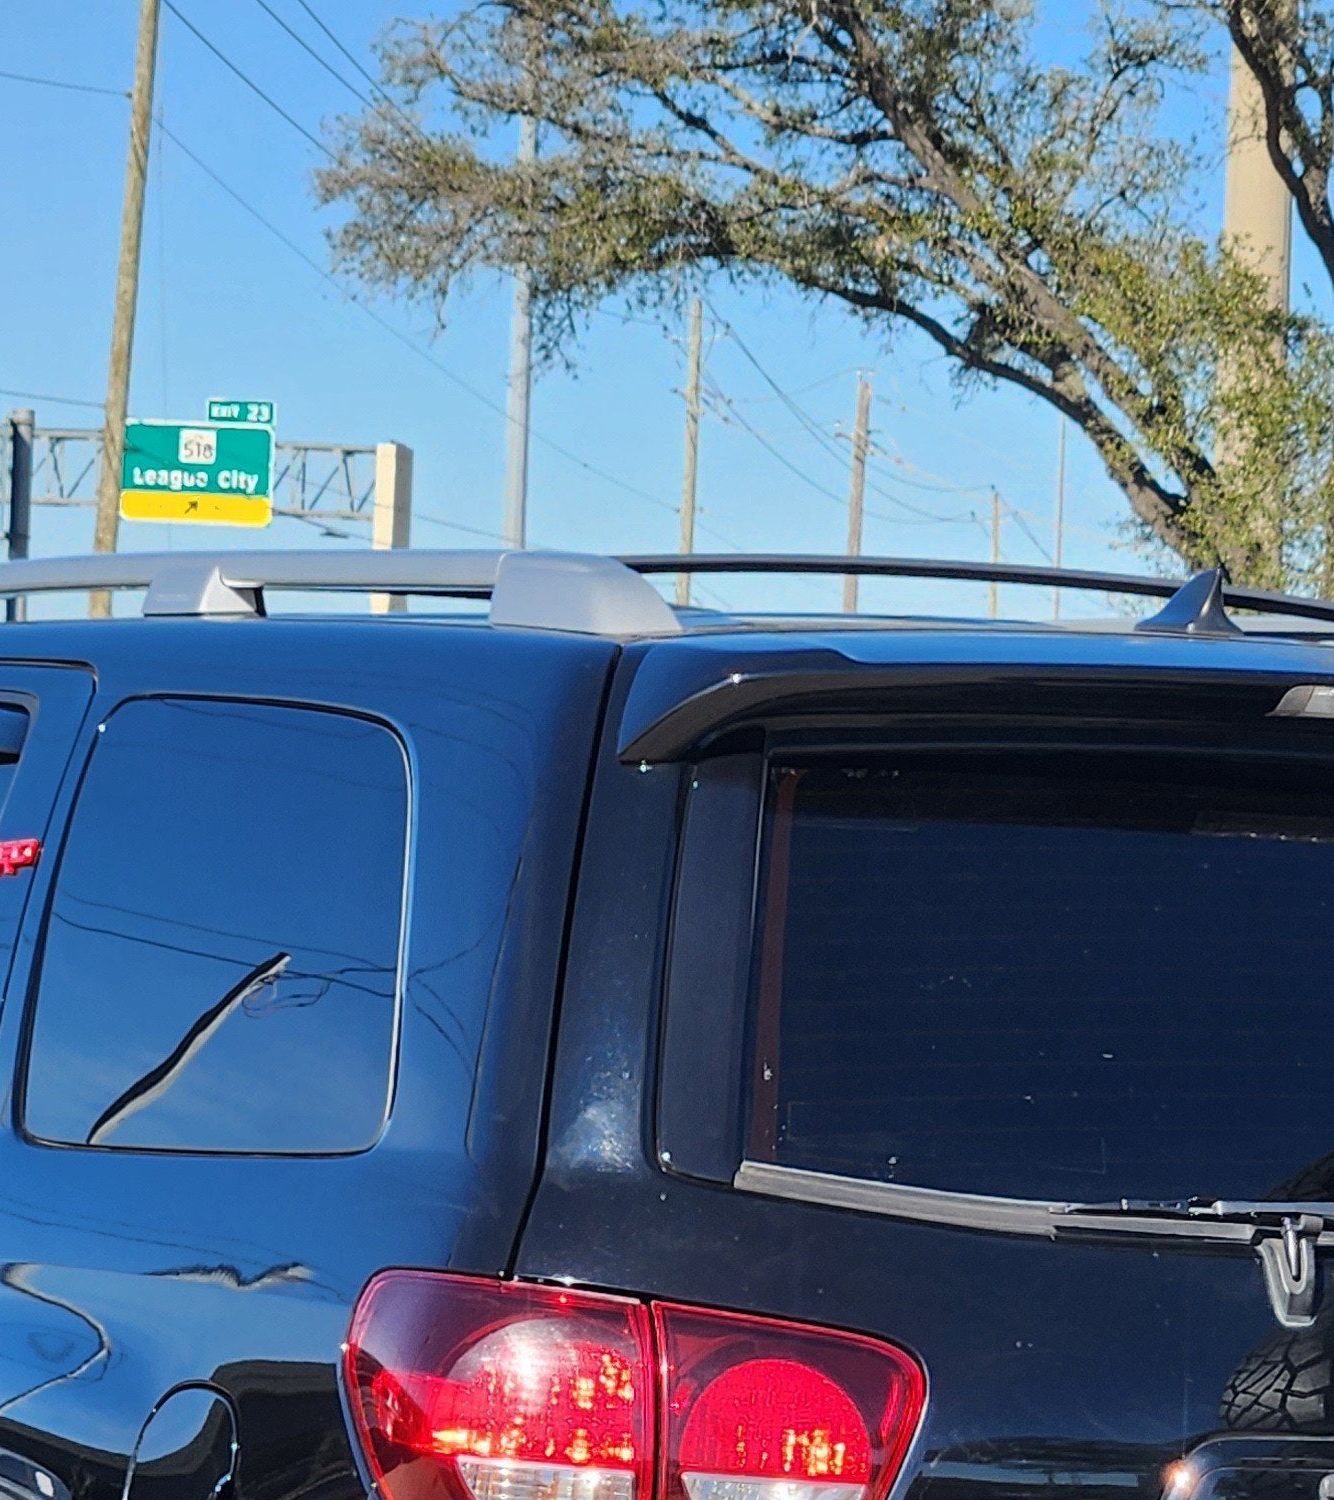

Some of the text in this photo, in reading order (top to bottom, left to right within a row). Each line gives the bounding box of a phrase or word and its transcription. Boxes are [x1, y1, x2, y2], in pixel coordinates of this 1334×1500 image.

[246, 404, 271, 422] 23
[183, 440, 213, 459] 518
[132, 466, 259, 495] League City
